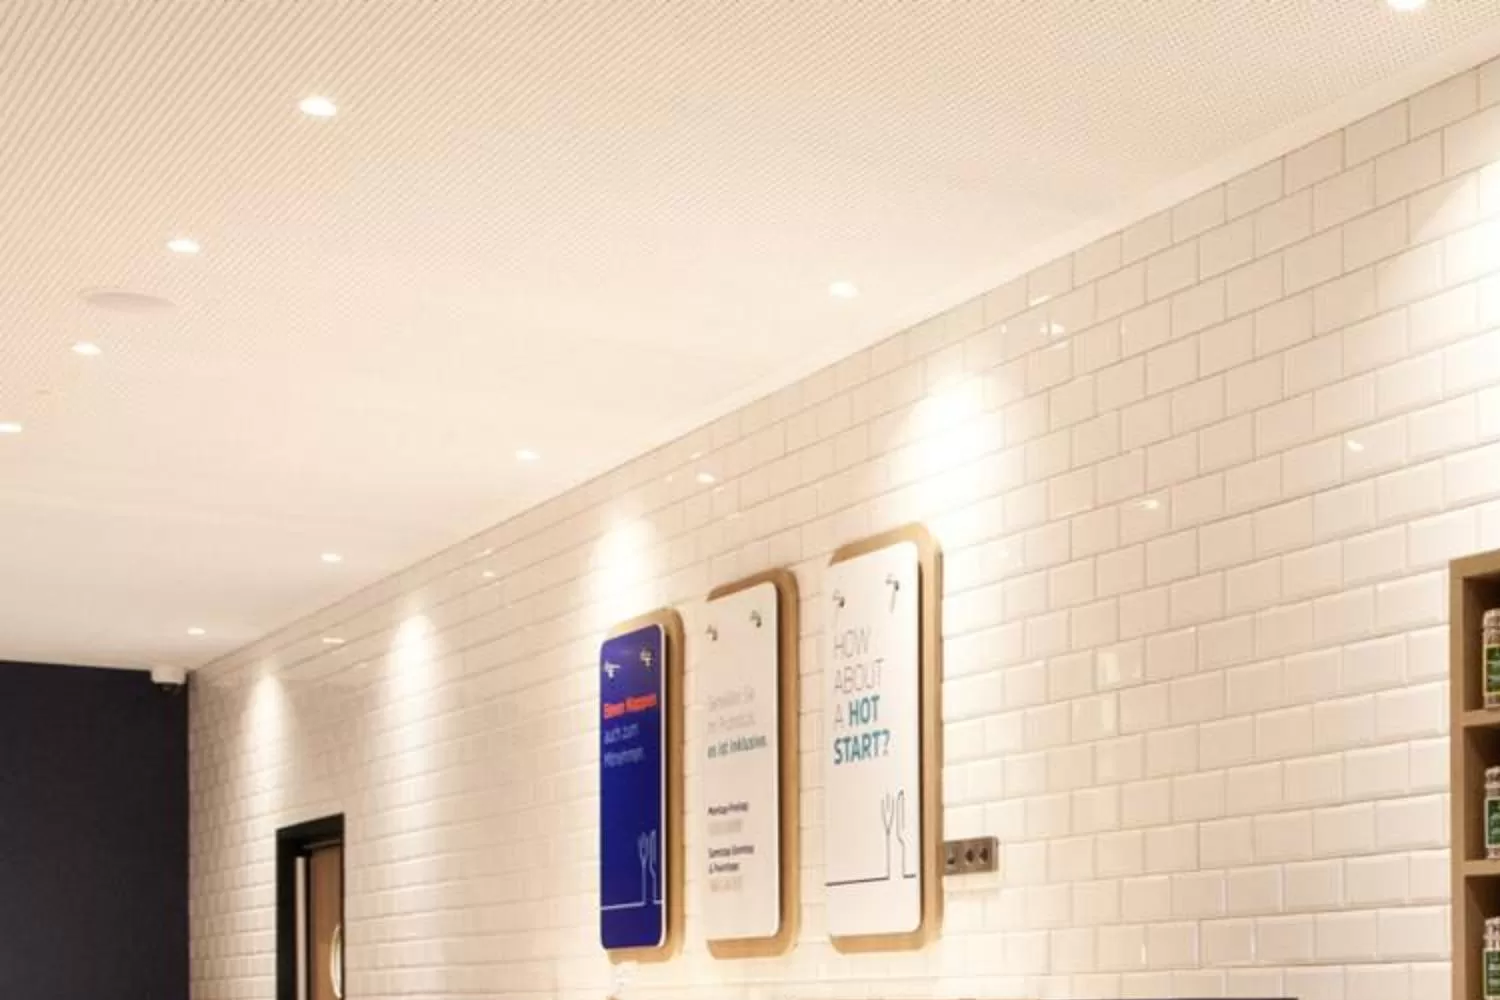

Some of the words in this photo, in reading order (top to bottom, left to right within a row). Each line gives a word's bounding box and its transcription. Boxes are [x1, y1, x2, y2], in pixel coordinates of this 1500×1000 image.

[834, 627, 871, 659] HOW
[834, 658, 885, 694] ABOUT
[834, 702, 845, 731] A
[848, 695, 881, 728] HOT
[833, 728, 890, 766] START?
